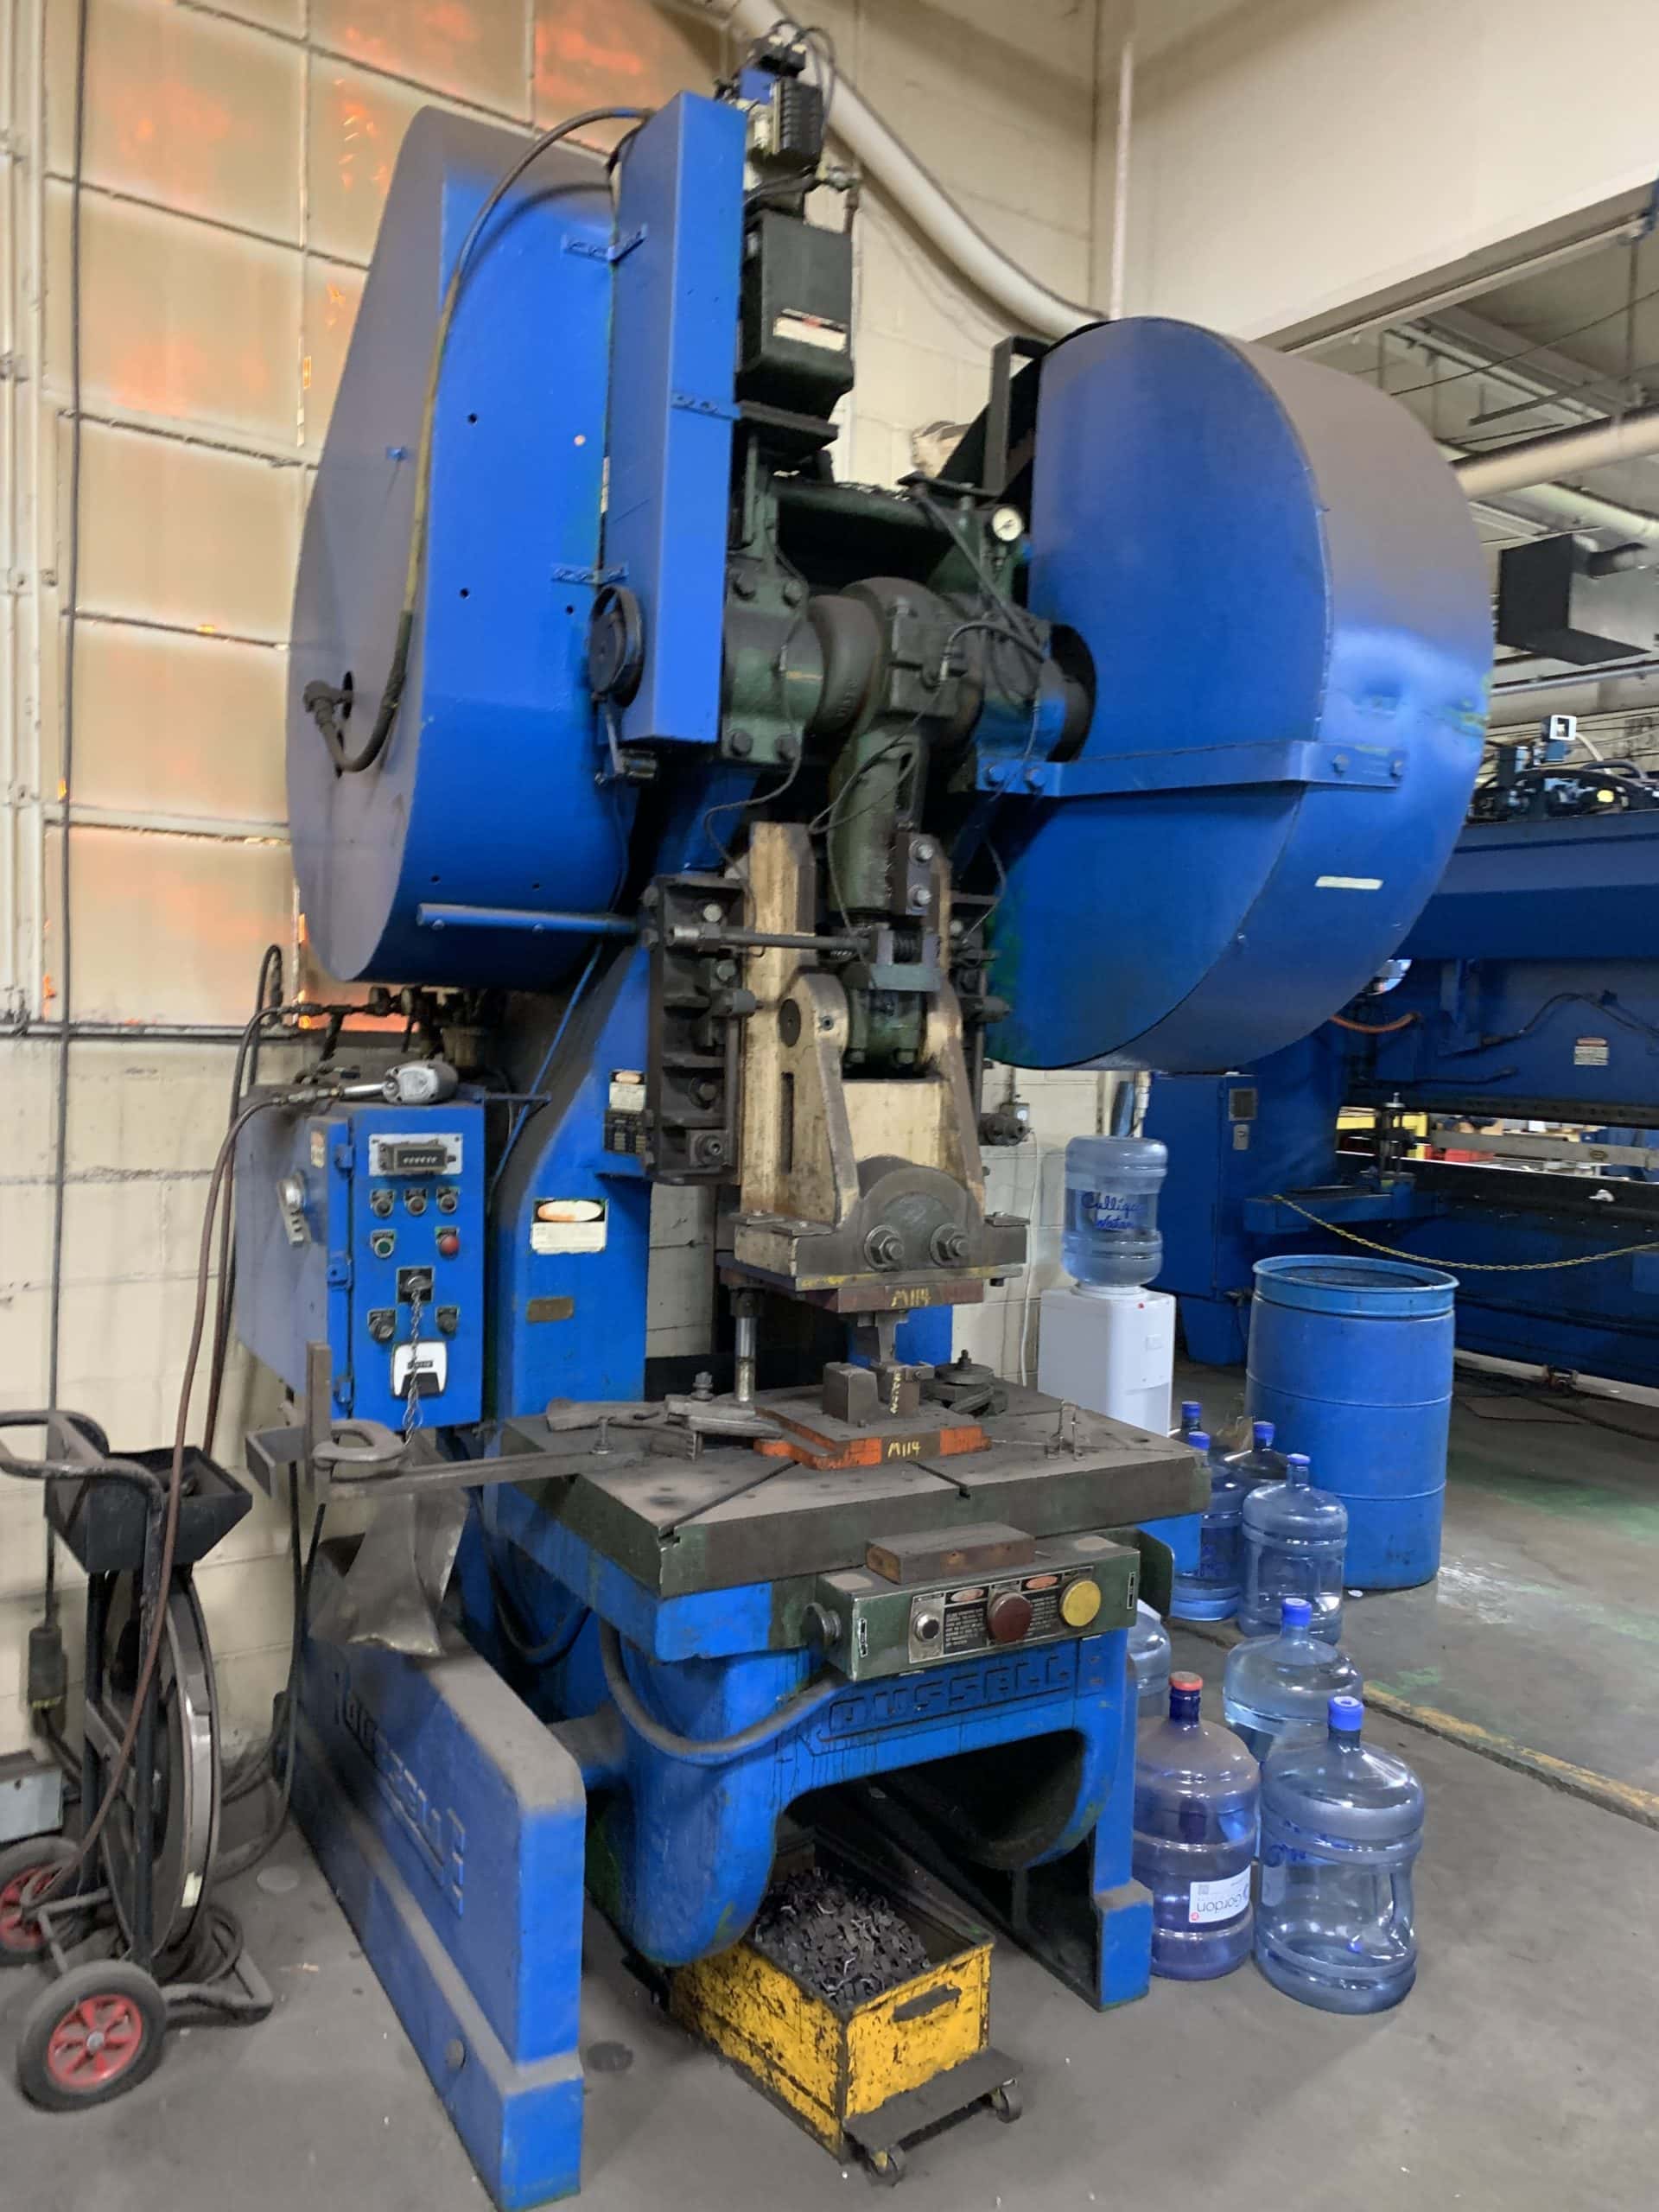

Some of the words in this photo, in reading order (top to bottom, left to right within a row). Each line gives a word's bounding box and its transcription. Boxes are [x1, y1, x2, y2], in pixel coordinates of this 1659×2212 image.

[890, 1287, 932, 1307] M114
[887, 1440, 922, 1460] M114
[1196, 1892, 1243, 1914] Gordon
